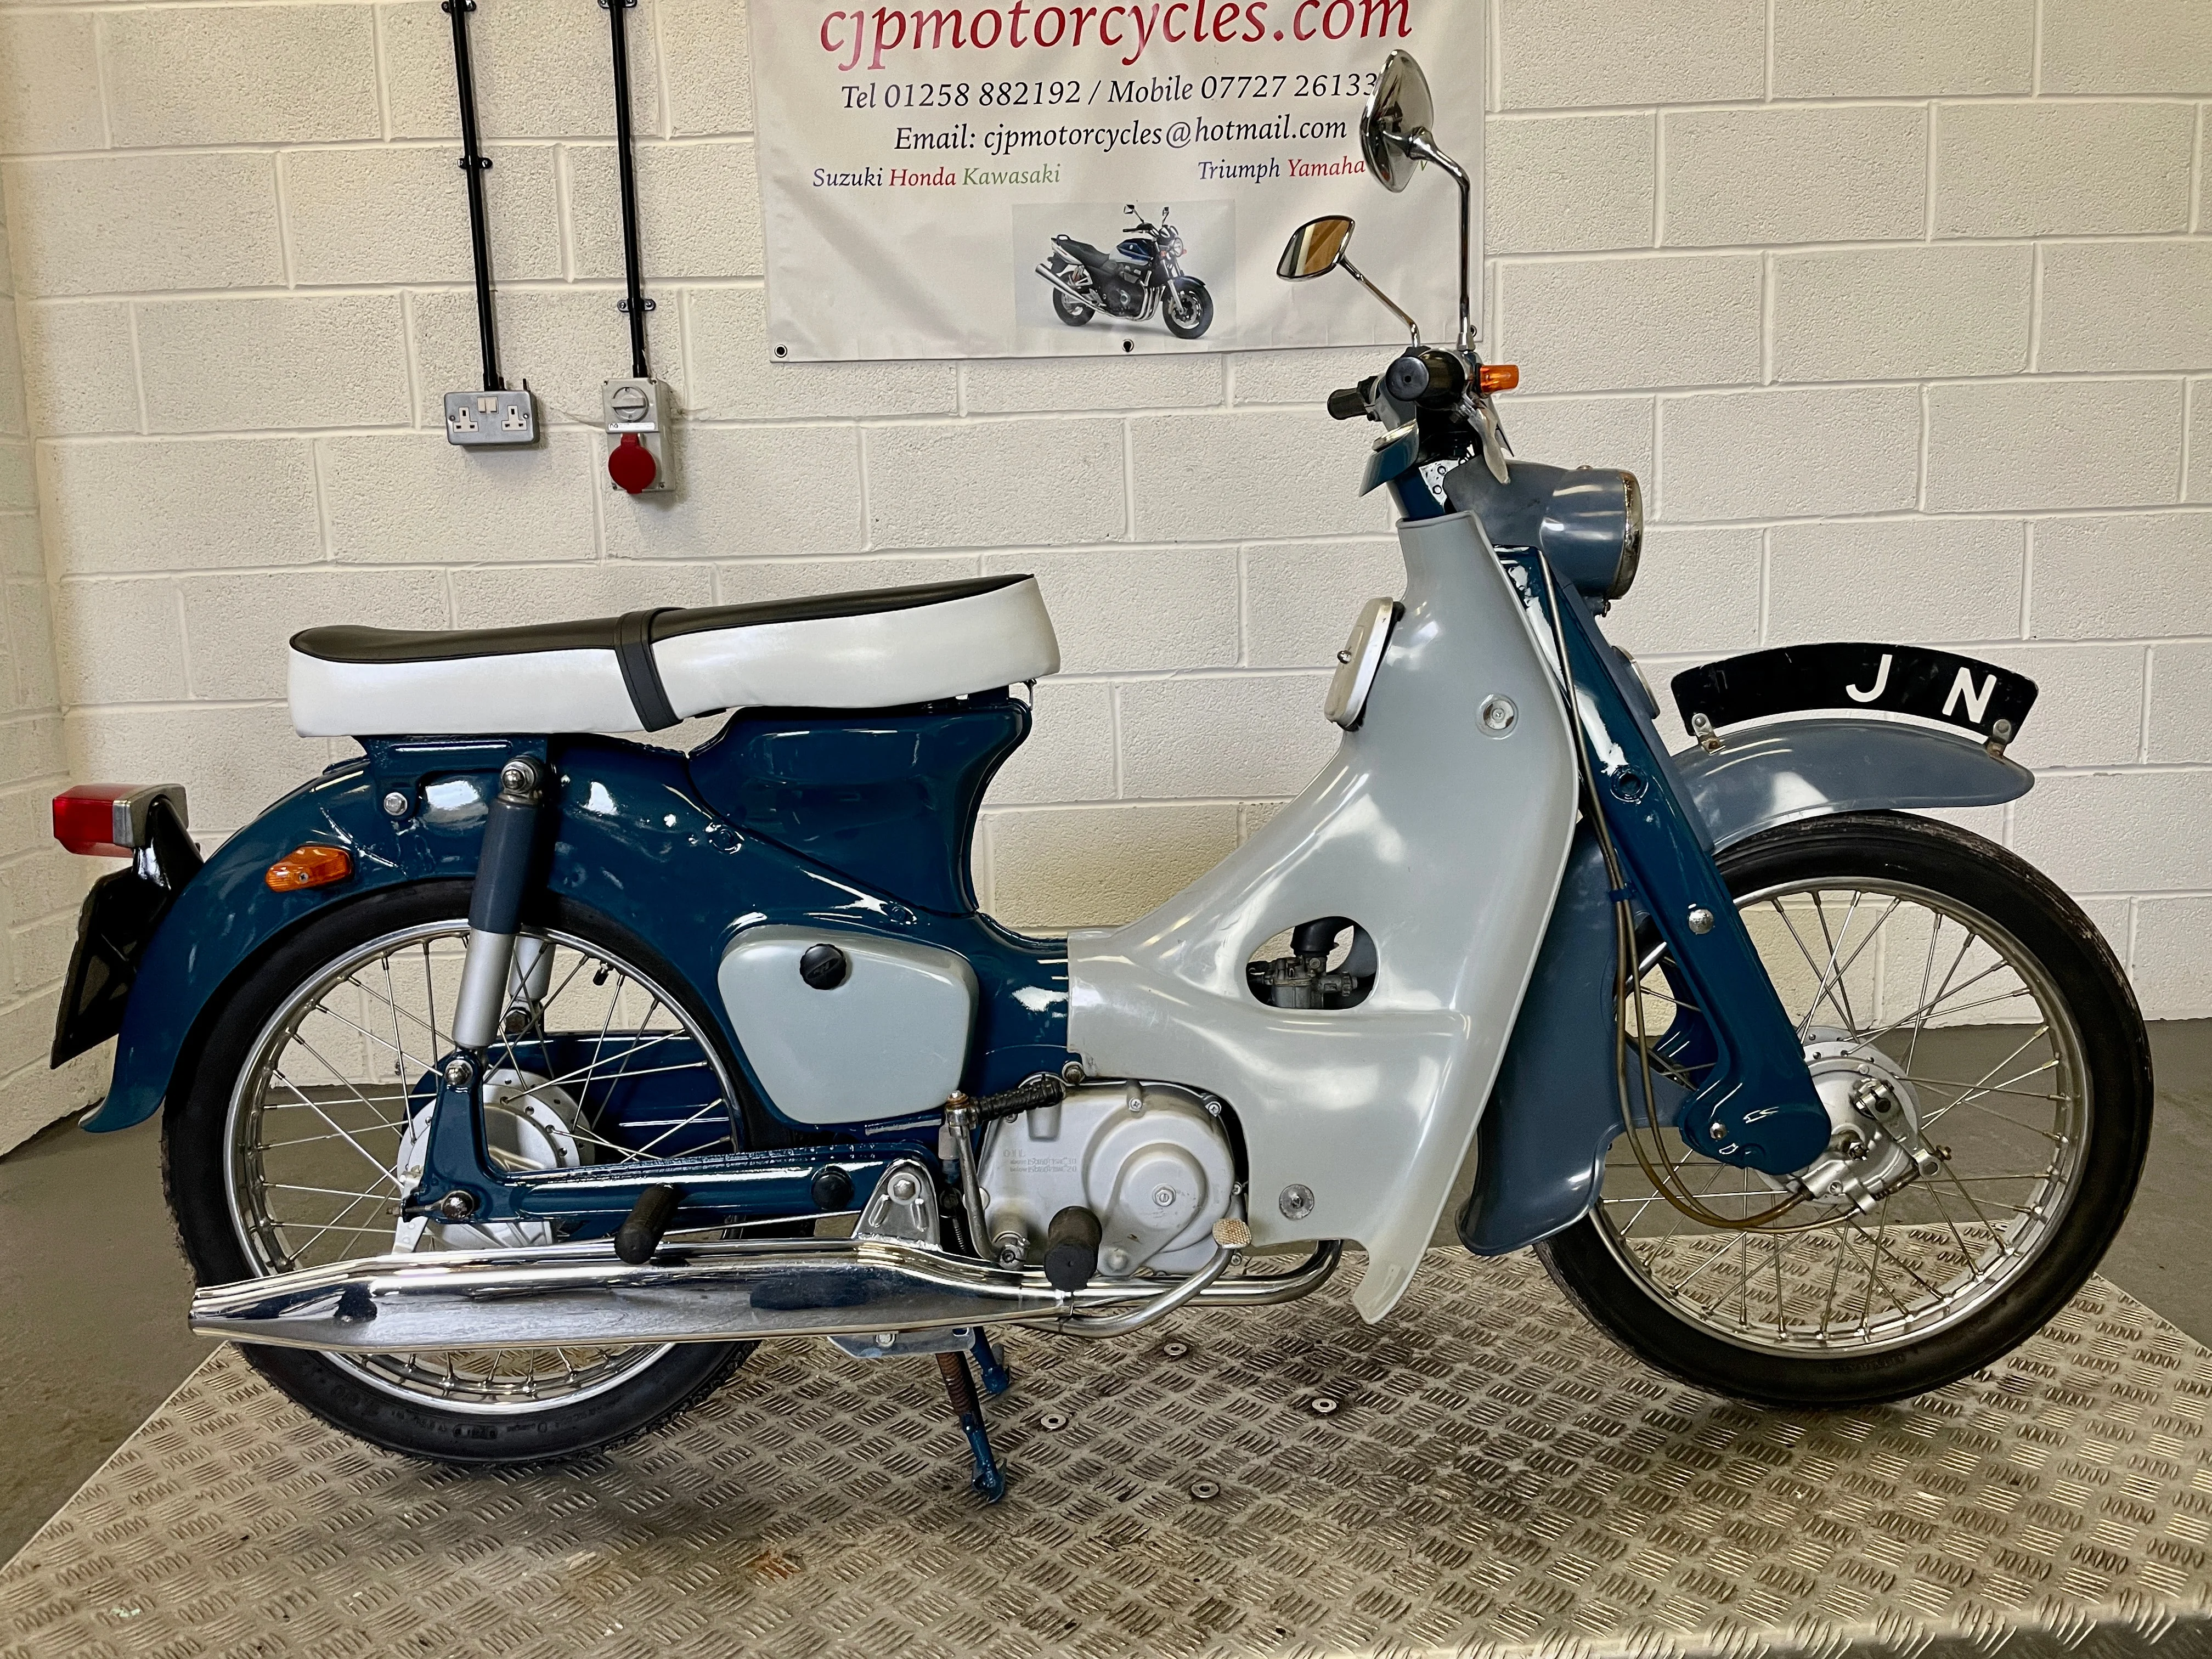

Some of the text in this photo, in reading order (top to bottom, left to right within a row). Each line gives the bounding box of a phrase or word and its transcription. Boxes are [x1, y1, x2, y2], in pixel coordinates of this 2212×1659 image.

[821, 0, 1413, 71] cjpmotorcycles.com
[841, 82, 877, 109] Tel
[884, 82, 970, 109] 01258
[978, 80, 1081, 107] 882192
[1087, 80, 1102, 105] /
[1107, 74, 1193, 103] Mobile
[1200, 75, 1287, 99] 07727
[894, 113, 1347, 156] Email: cjpmotorcycles@hotmail.com
[812, 163, 1061, 187] Suzuki Honda Kawasaki
[1198, 155, 1365, 184] Triumph Yamaha
[1846, 654, 1997, 724] J N
